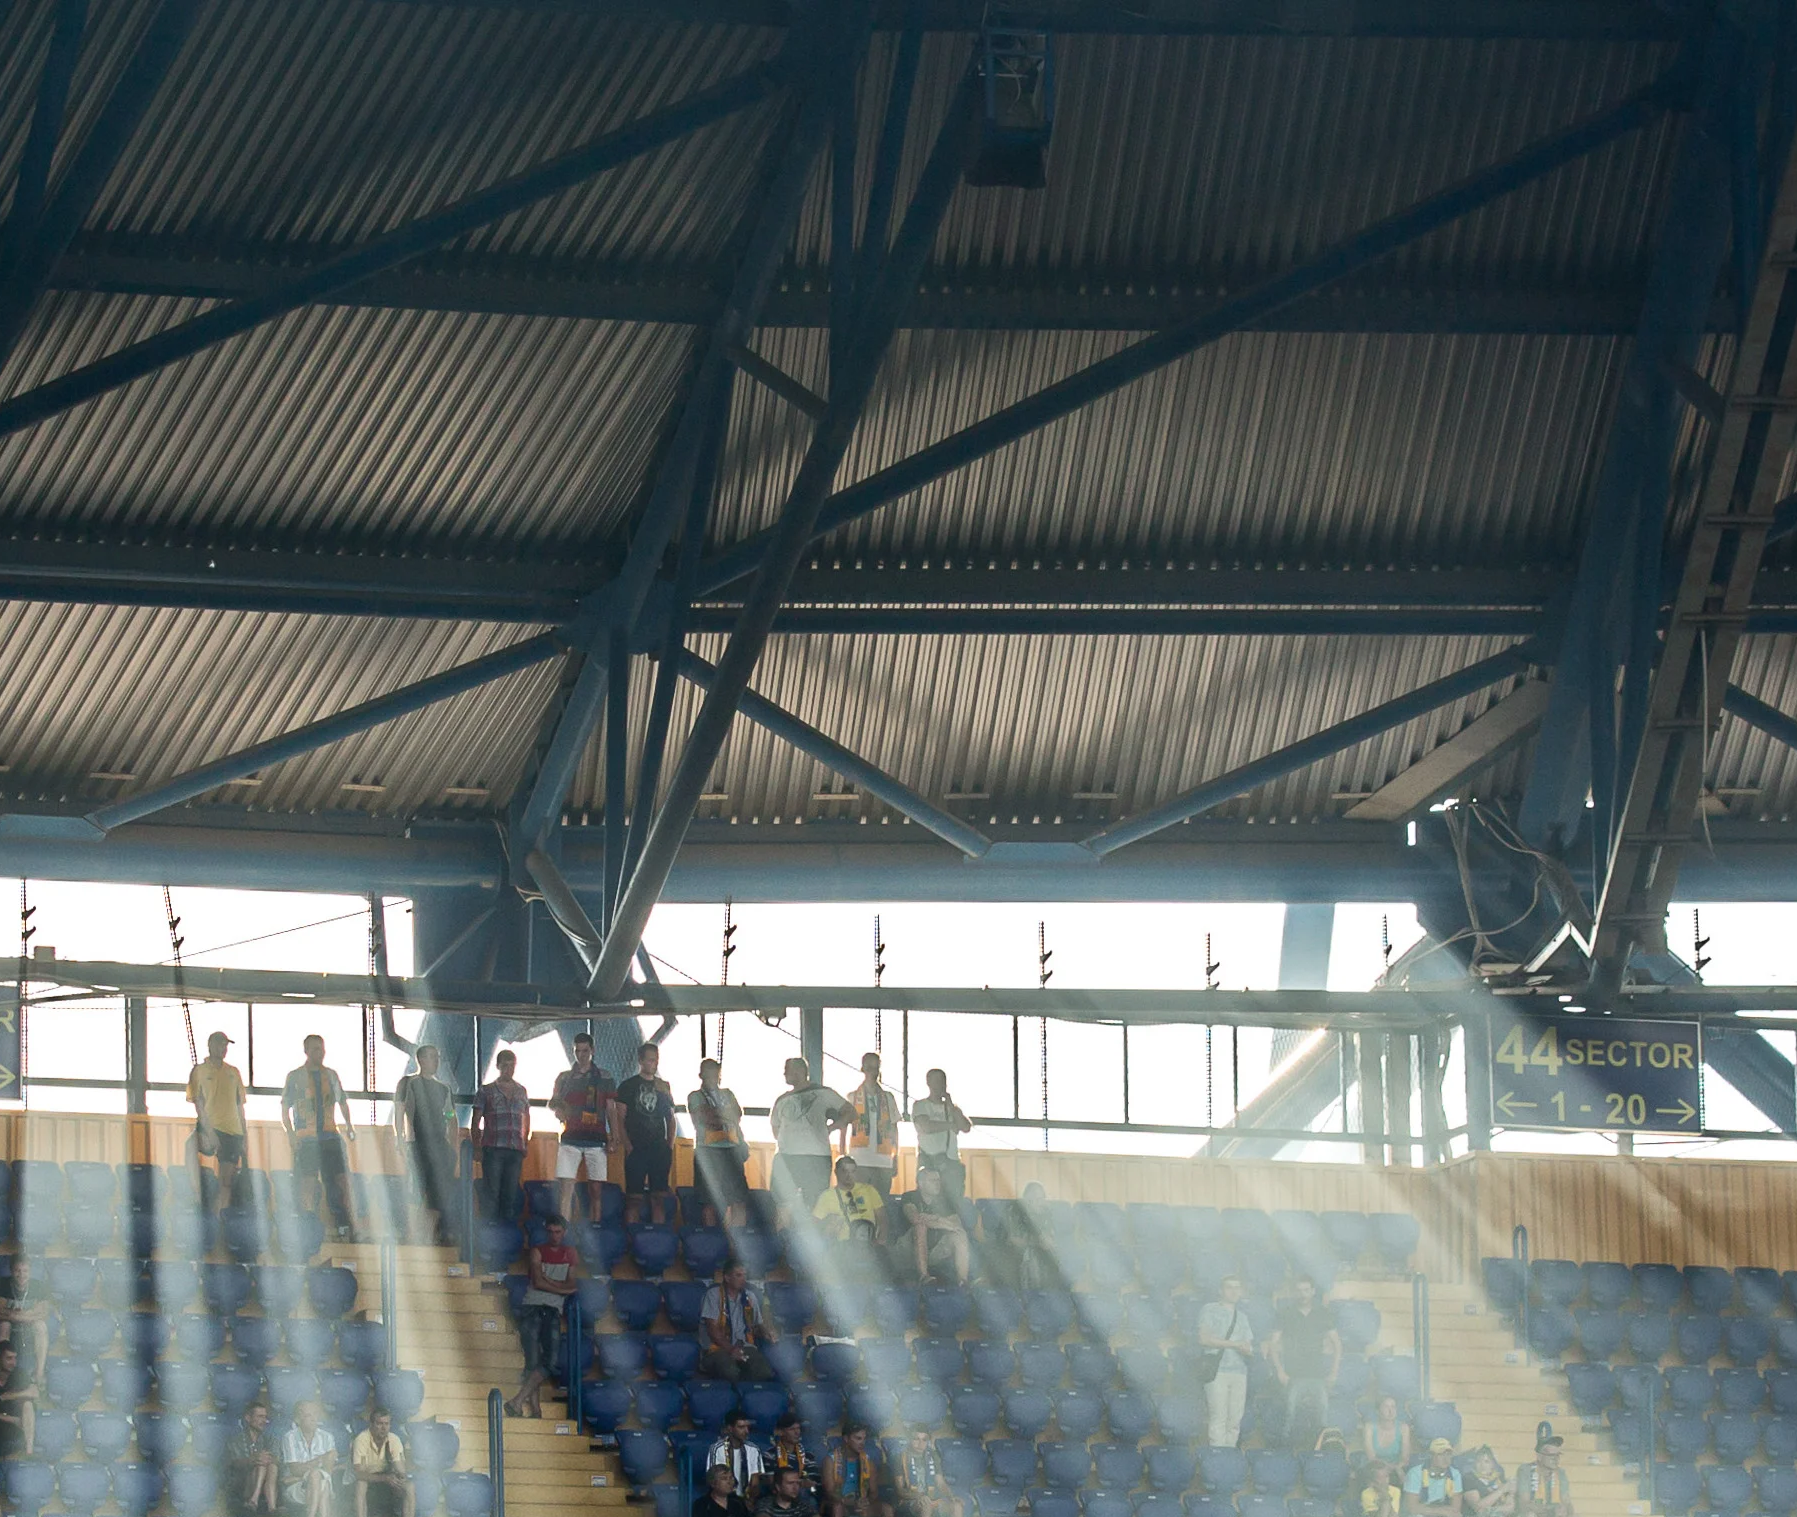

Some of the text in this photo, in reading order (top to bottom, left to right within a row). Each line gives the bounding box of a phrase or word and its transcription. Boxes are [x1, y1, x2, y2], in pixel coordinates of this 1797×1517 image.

[1496, 1024, 1695, 1077] 44 SECTOR
[1550, 1091, 1566, 1122] 1
[1606, 1093, 1646, 1125] 20
